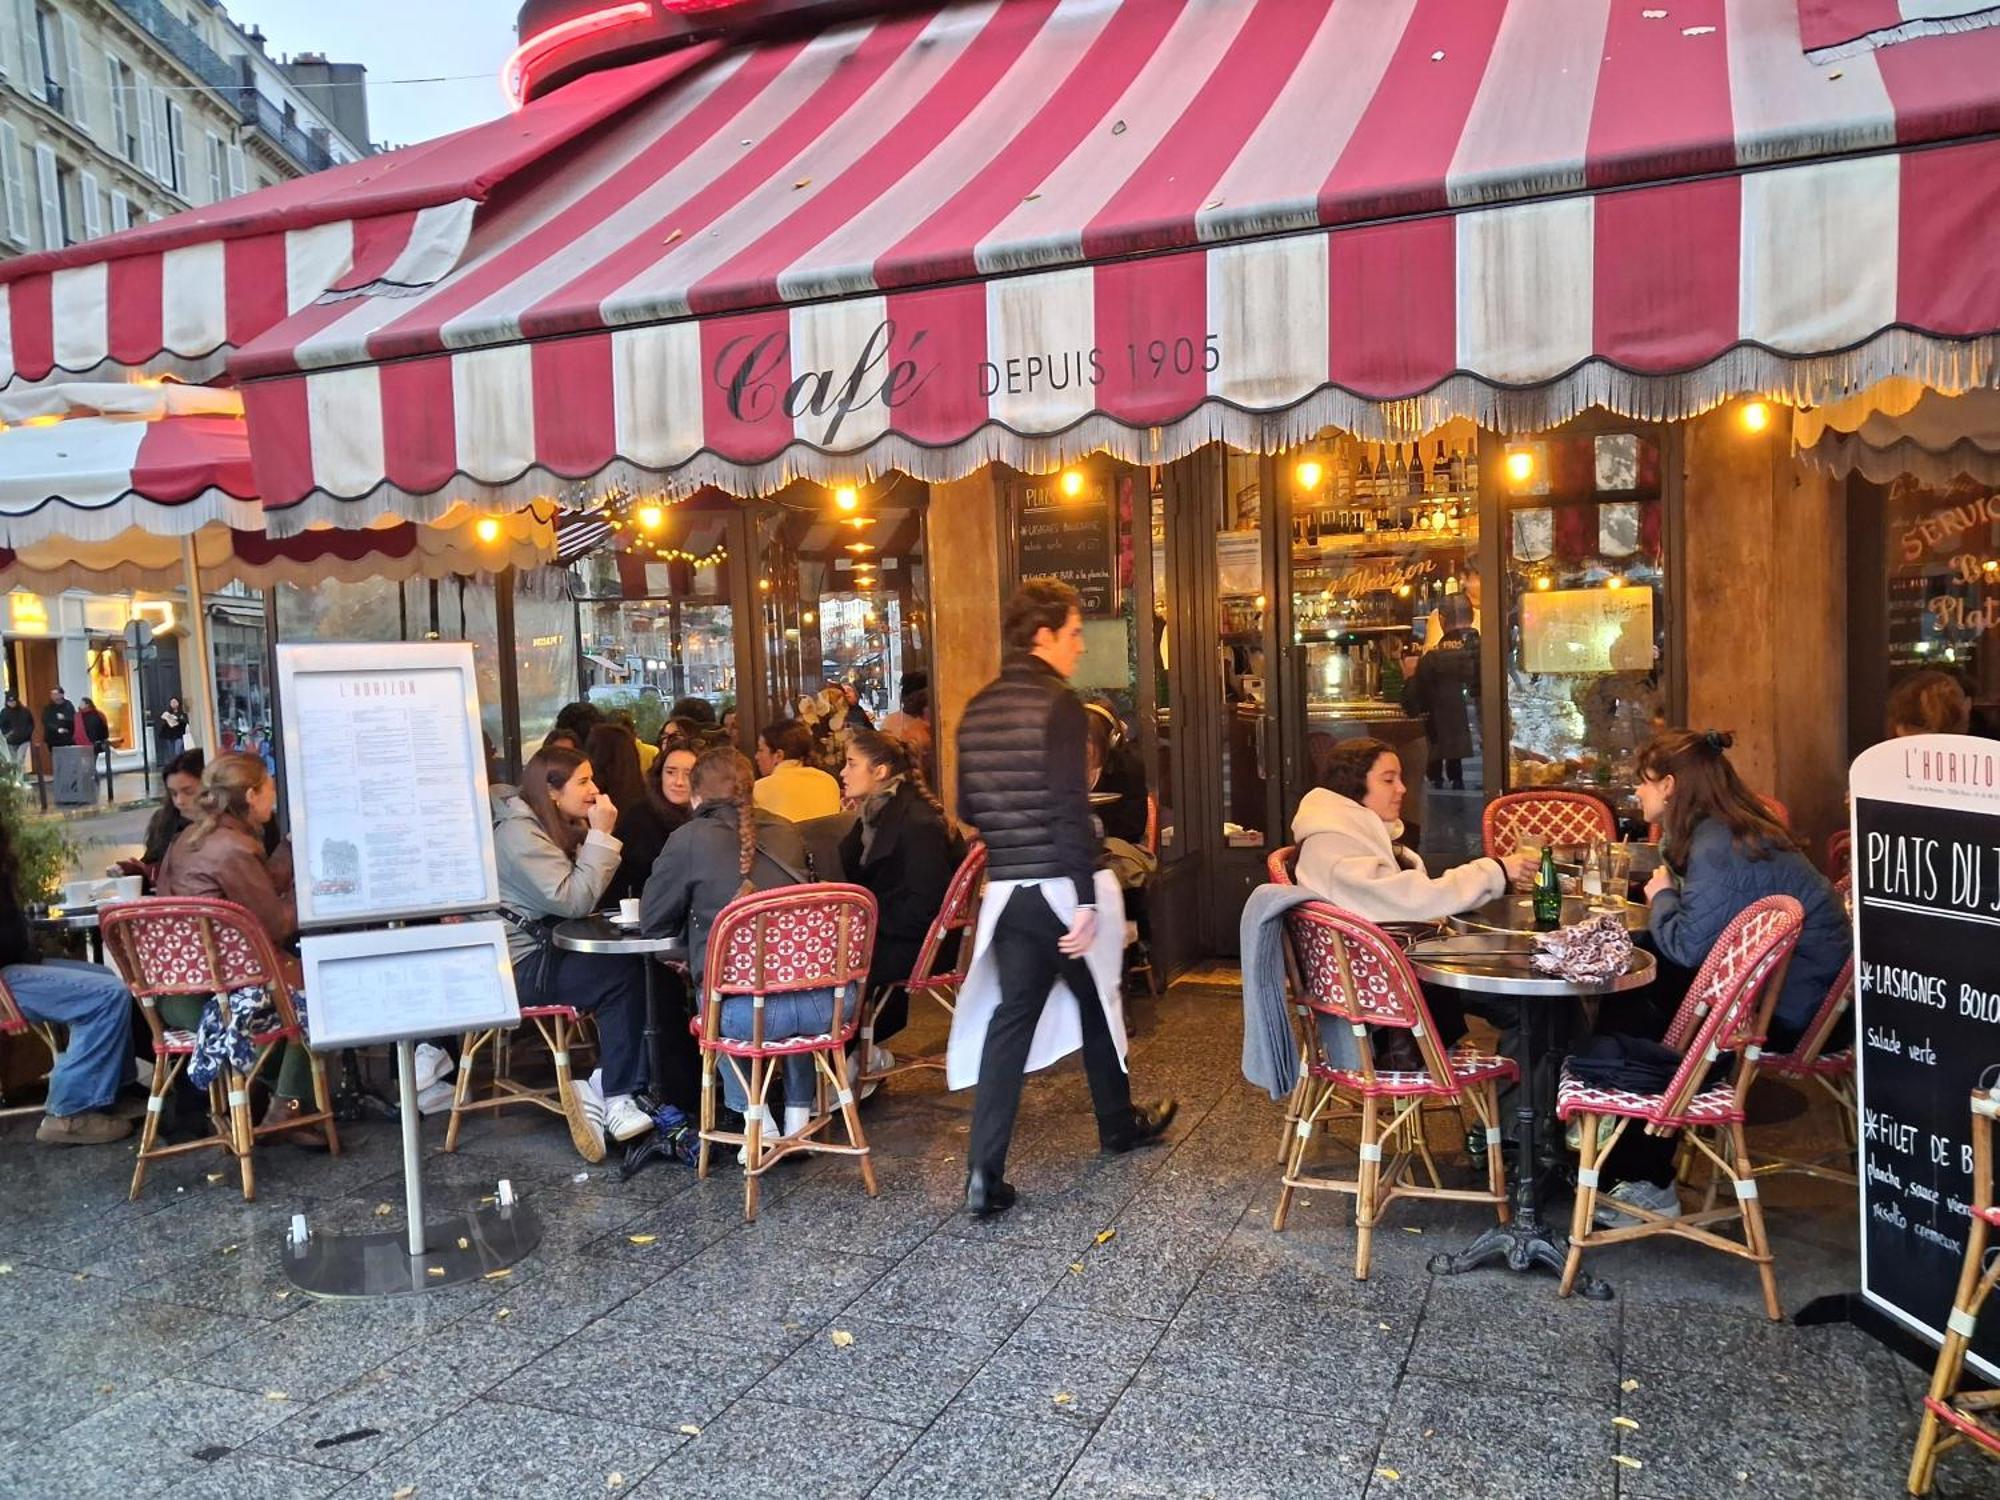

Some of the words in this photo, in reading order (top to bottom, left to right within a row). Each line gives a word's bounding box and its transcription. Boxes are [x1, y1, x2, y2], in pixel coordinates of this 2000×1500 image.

[713, 319, 941, 446] Café
[977, 349, 1106, 398] DEPUIS
[1127, 333, 1221, 381] 1905
[1905, 747, 2000, 788] L'HORIZO
[1868, 831, 1940, 901] PLATS
[1951, 842, 1981, 908] DU
[1876, 964, 1948, 1010] LASAGNES
[1867, 1025, 1901, 1055] Salade
[1908, 1037, 1938, 1066] verte
[1931, 1134, 1950, 1166] DE
